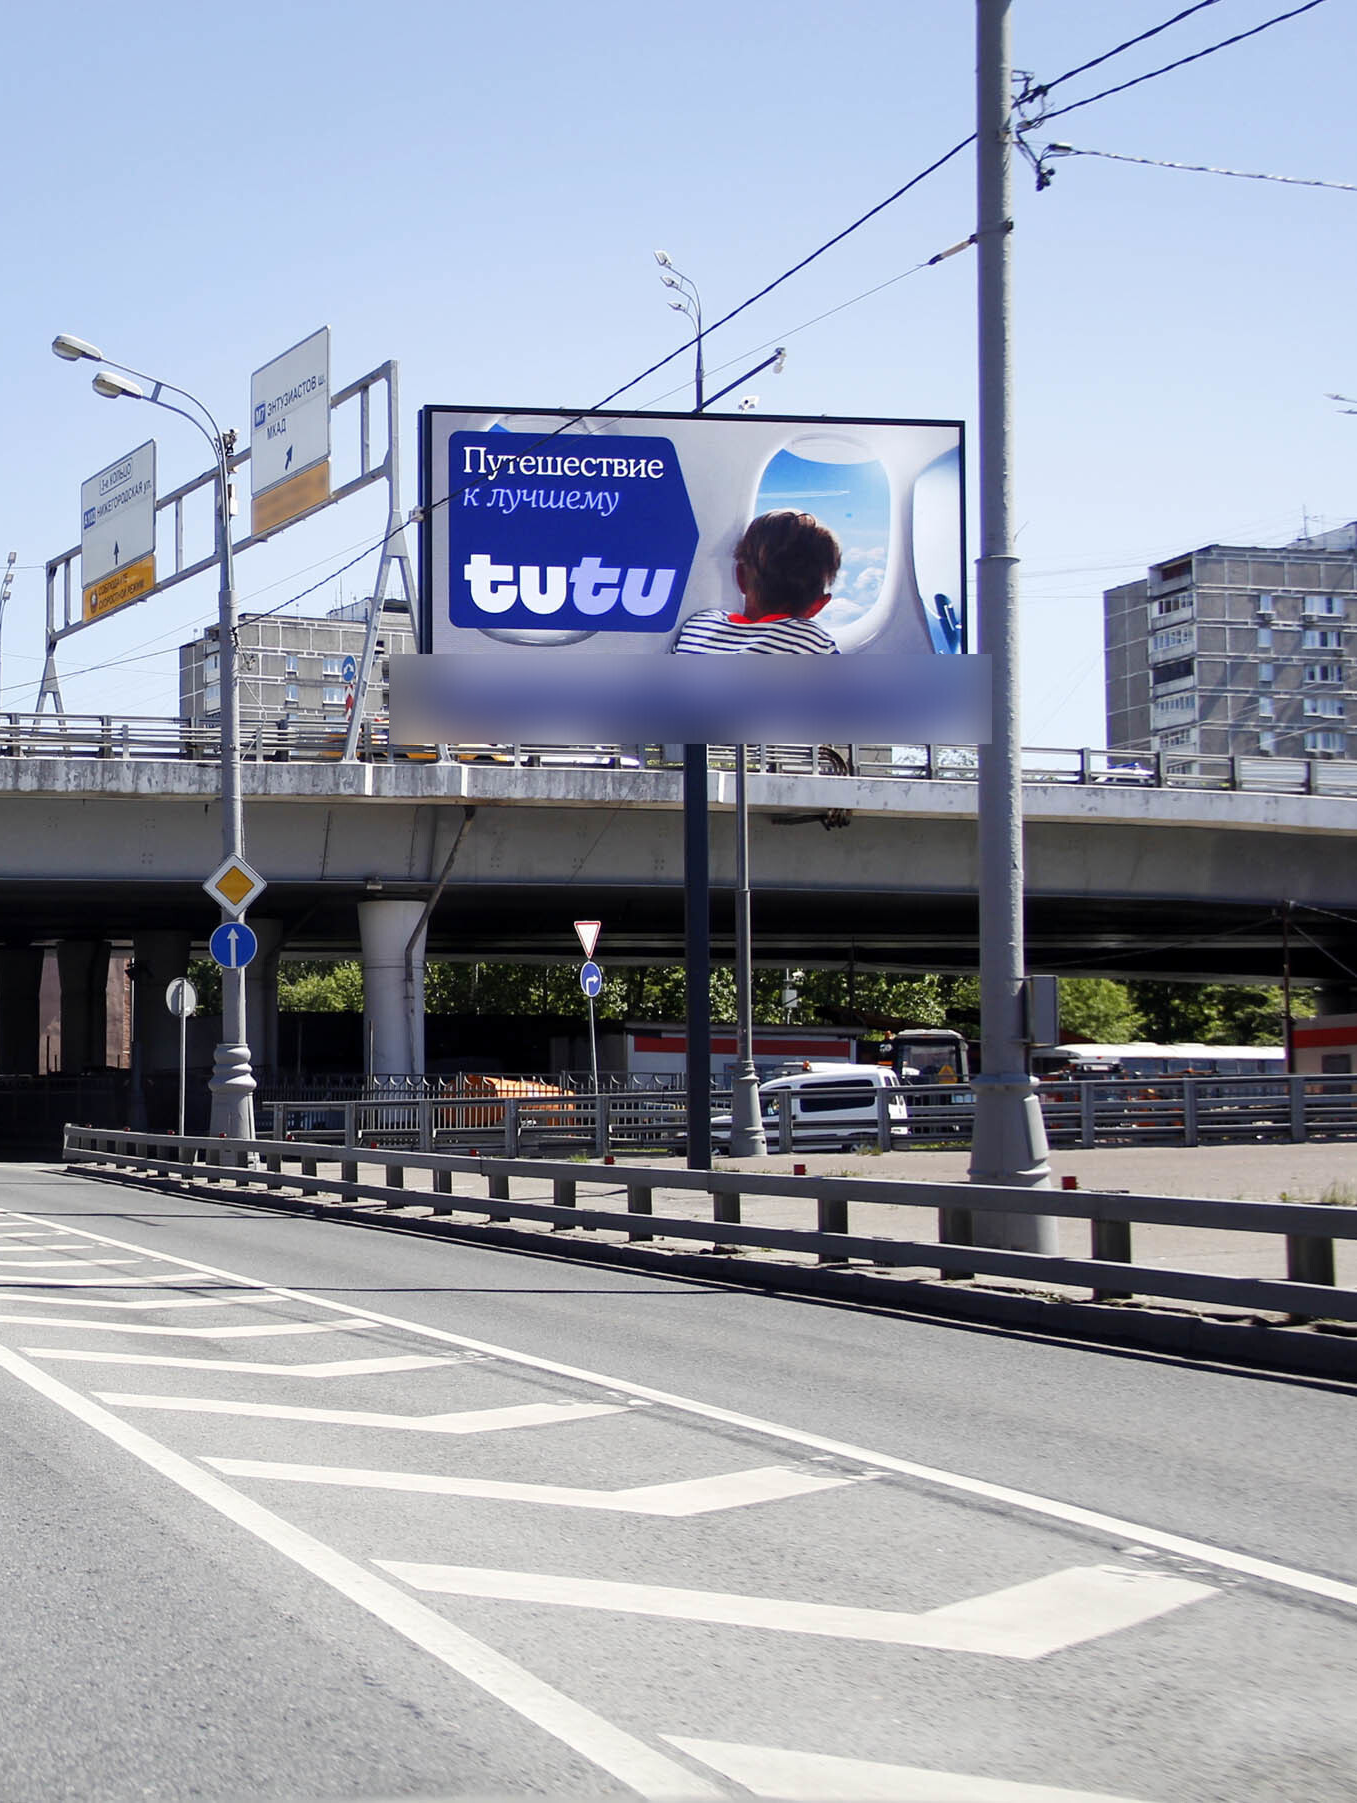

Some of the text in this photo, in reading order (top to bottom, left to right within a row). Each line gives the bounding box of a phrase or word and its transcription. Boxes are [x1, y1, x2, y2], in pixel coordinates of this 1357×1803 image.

[267, 376, 316, 416] ЭНТУЗИАСТОВ
[267, 418, 286, 440] МКАД
[110, 462, 131, 486] КОЛЬЦО
[463, 446, 664, 480] Путешествие
[97, 481, 142, 518] НИЖЕГОРОДСКАЯ
[463, 488, 619, 516] к лучшему
[464, 554, 676, 616] tutu
